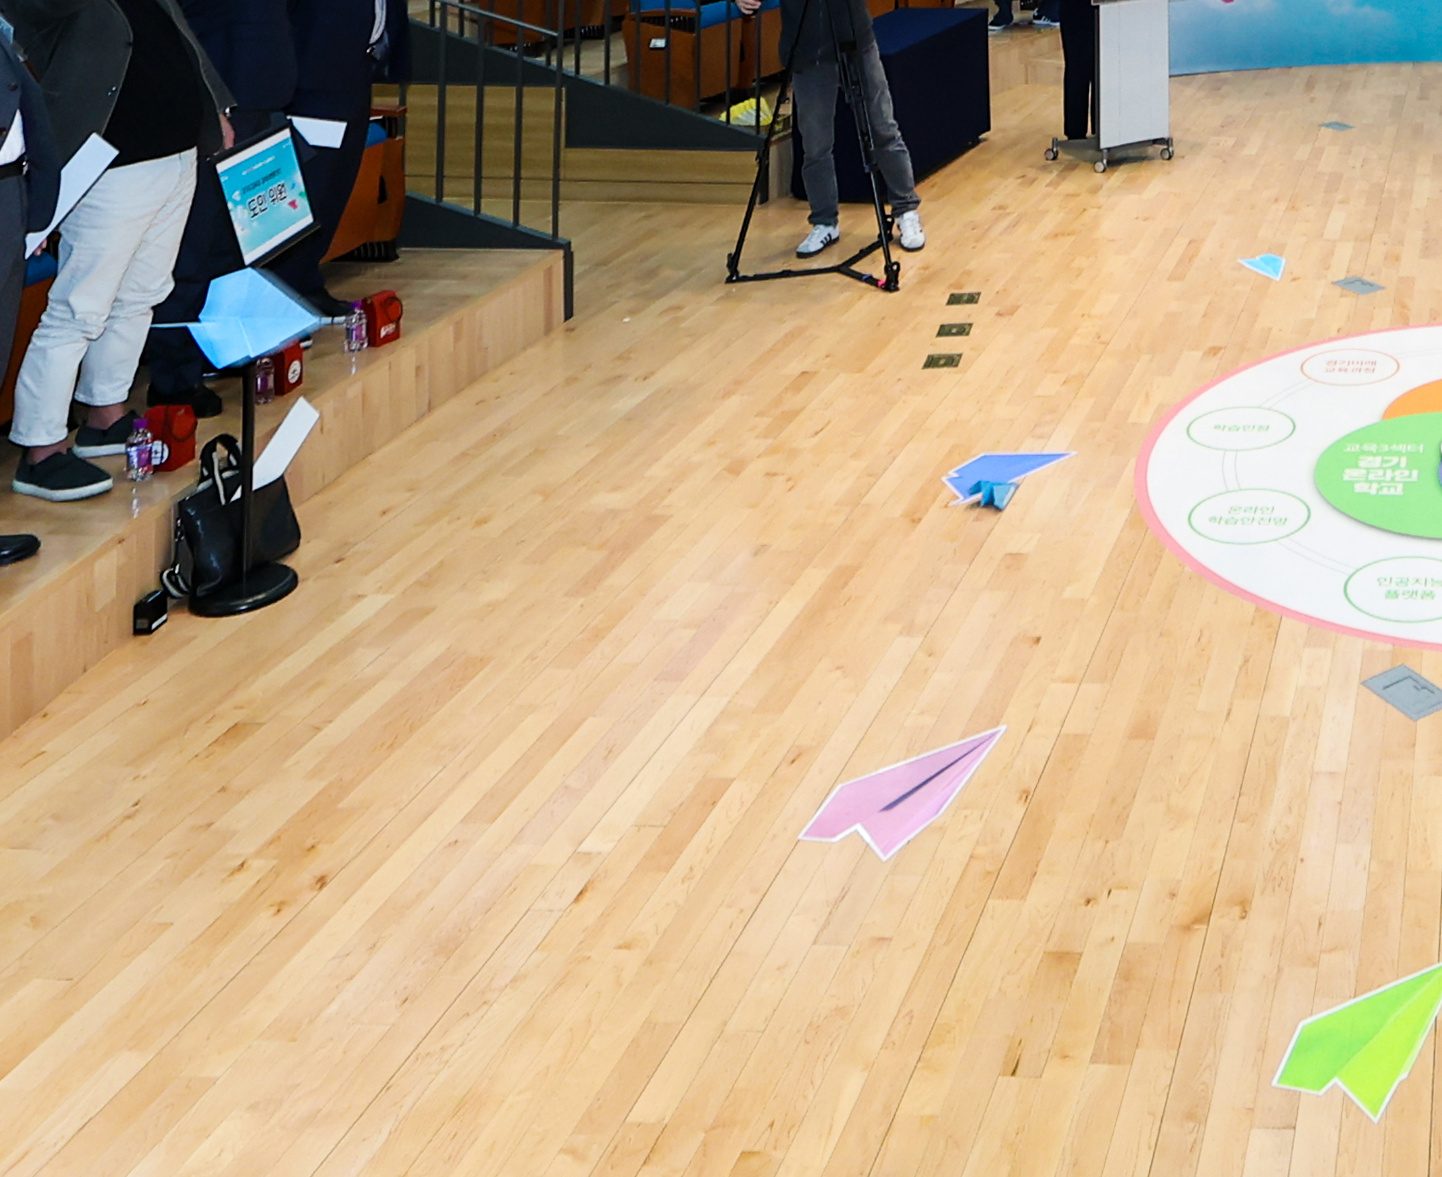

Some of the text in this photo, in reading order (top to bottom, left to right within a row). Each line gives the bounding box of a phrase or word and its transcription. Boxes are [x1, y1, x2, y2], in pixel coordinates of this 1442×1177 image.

[1343, 443, 1424, 454] 교육3섹터
[1358, 455, 1408, 468] 경기
[1342, 469, 1419, 482] 온라인
[1353, 483, 1404, 495] 학교
[1228, 506, 1275, 514] 온라인
[1384, 589, 1436, 600] 플랫폼
